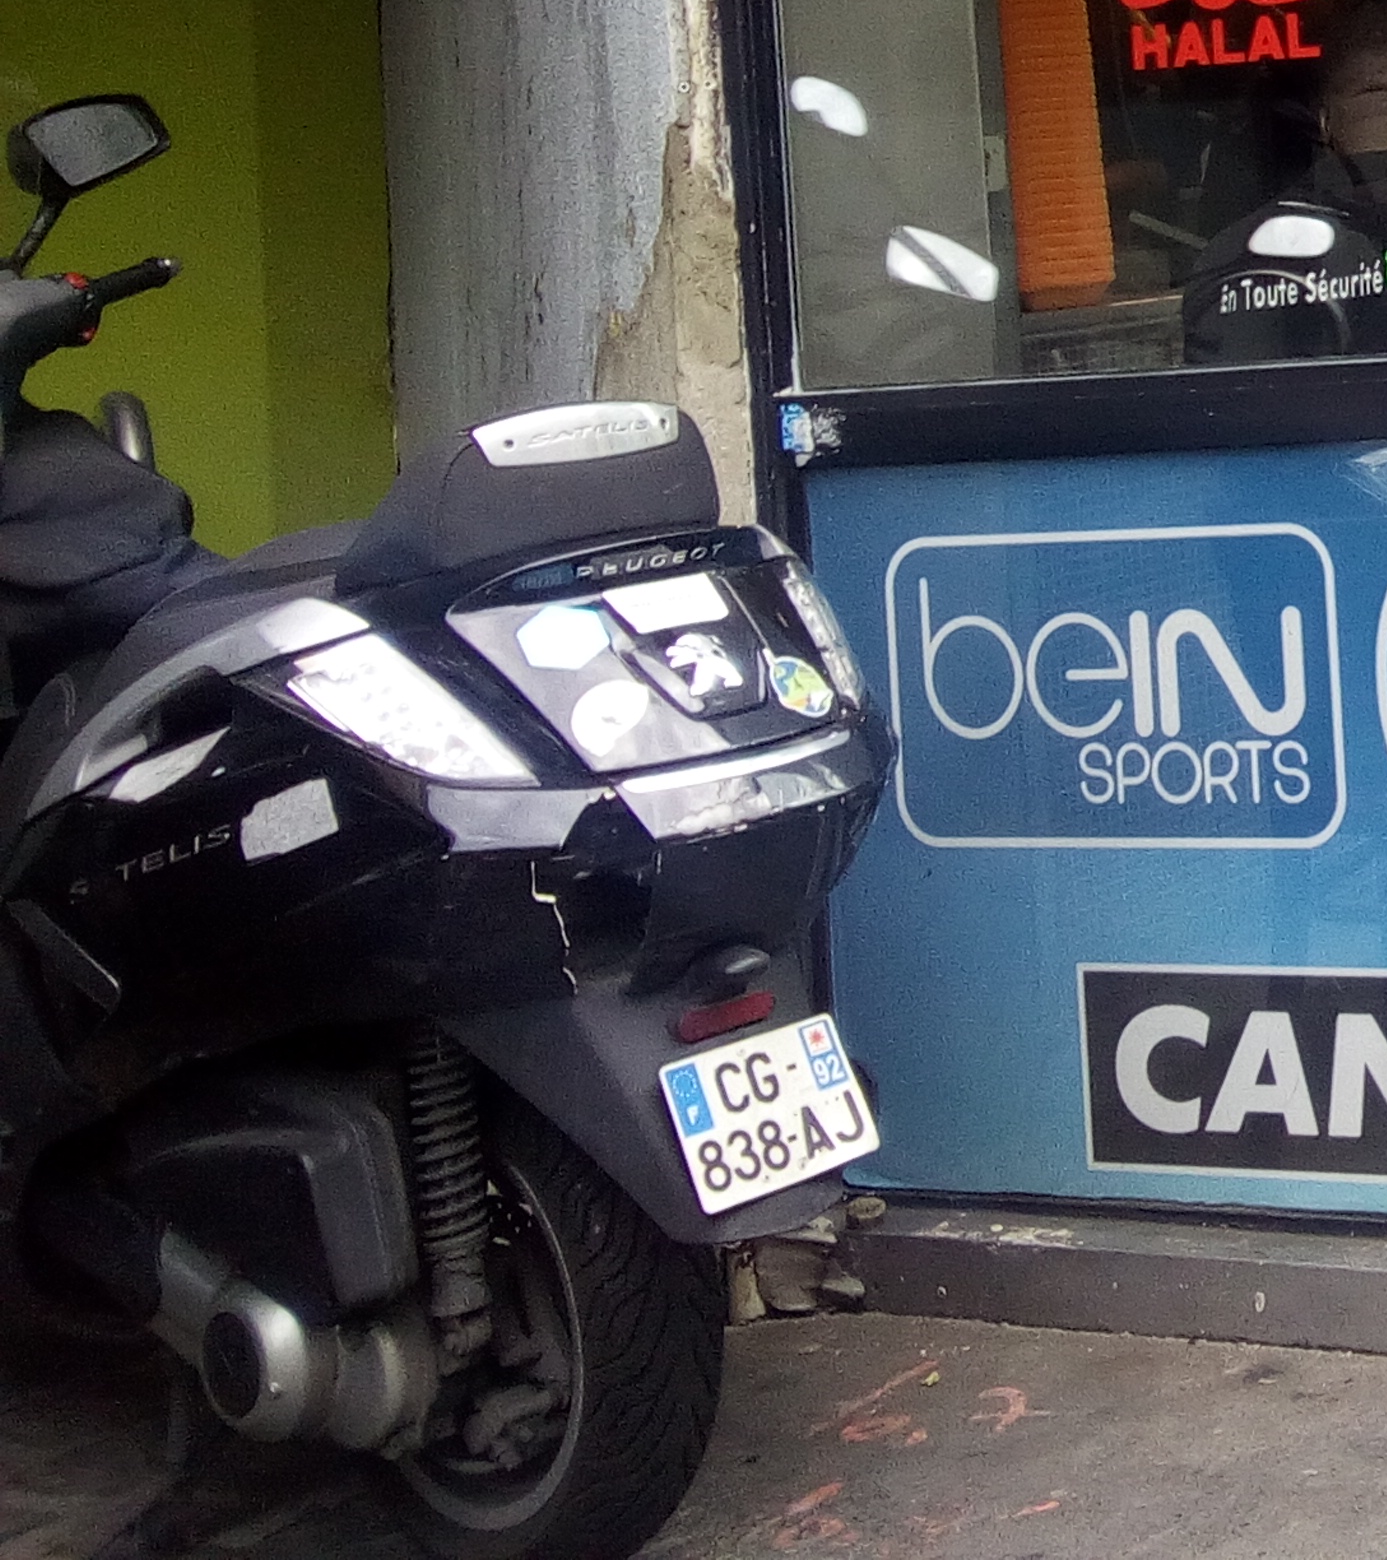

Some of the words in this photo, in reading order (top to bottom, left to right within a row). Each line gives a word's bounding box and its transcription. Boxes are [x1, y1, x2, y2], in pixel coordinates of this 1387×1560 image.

[1131, 12, 1322, 71] HALAL
[1240, 277, 1300, 311] Toute
[1303, 258, 1385, 304] Sécurité
[526, 418, 654, 448] SATELIS
[575, 542, 726, 578] PEUGEOT
[1079, 739, 1310, 806] SPORTS
[68, 823, 232, 896] STELIS
[813, 1053, 846, 1086] 92
[686, 1104, 700, 1127] F
[698, 1089, 865, 1192] 838-AJ
